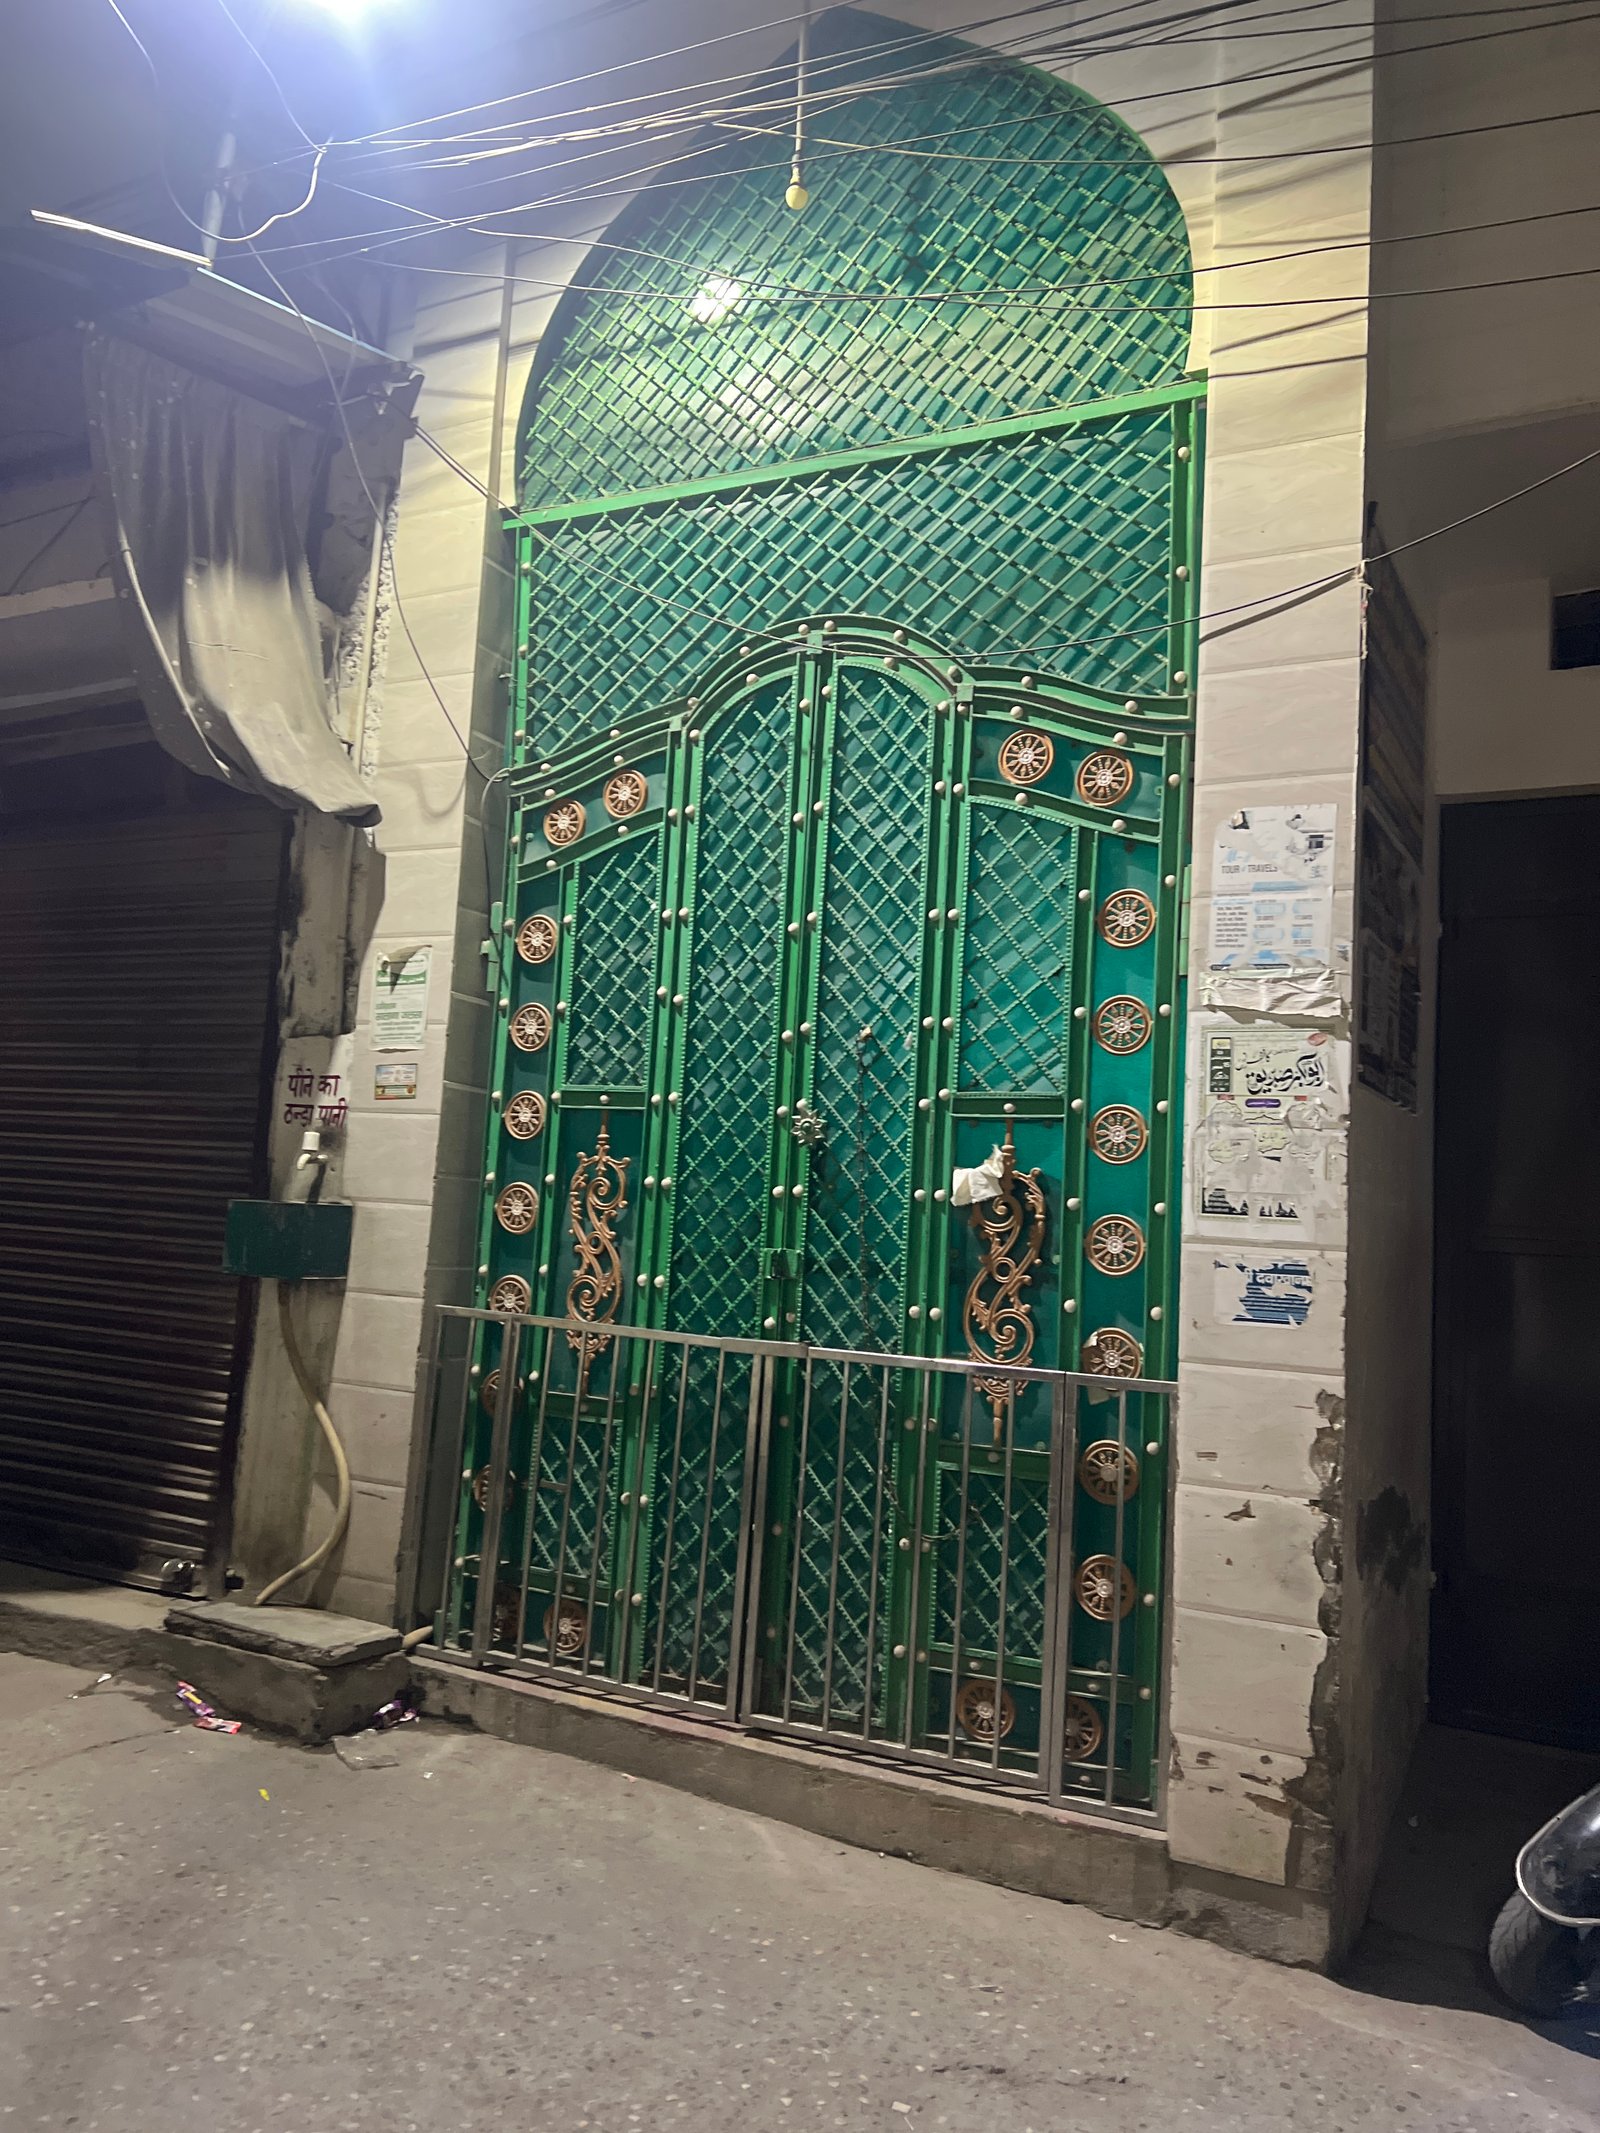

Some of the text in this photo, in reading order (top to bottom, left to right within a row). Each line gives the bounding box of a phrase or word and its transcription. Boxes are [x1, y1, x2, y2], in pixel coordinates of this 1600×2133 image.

[1221, 865, 1240, 874] TOUR
[288, 1067, 341, 1097] पीने का
[318, 1097, 349, 1128] पानी
